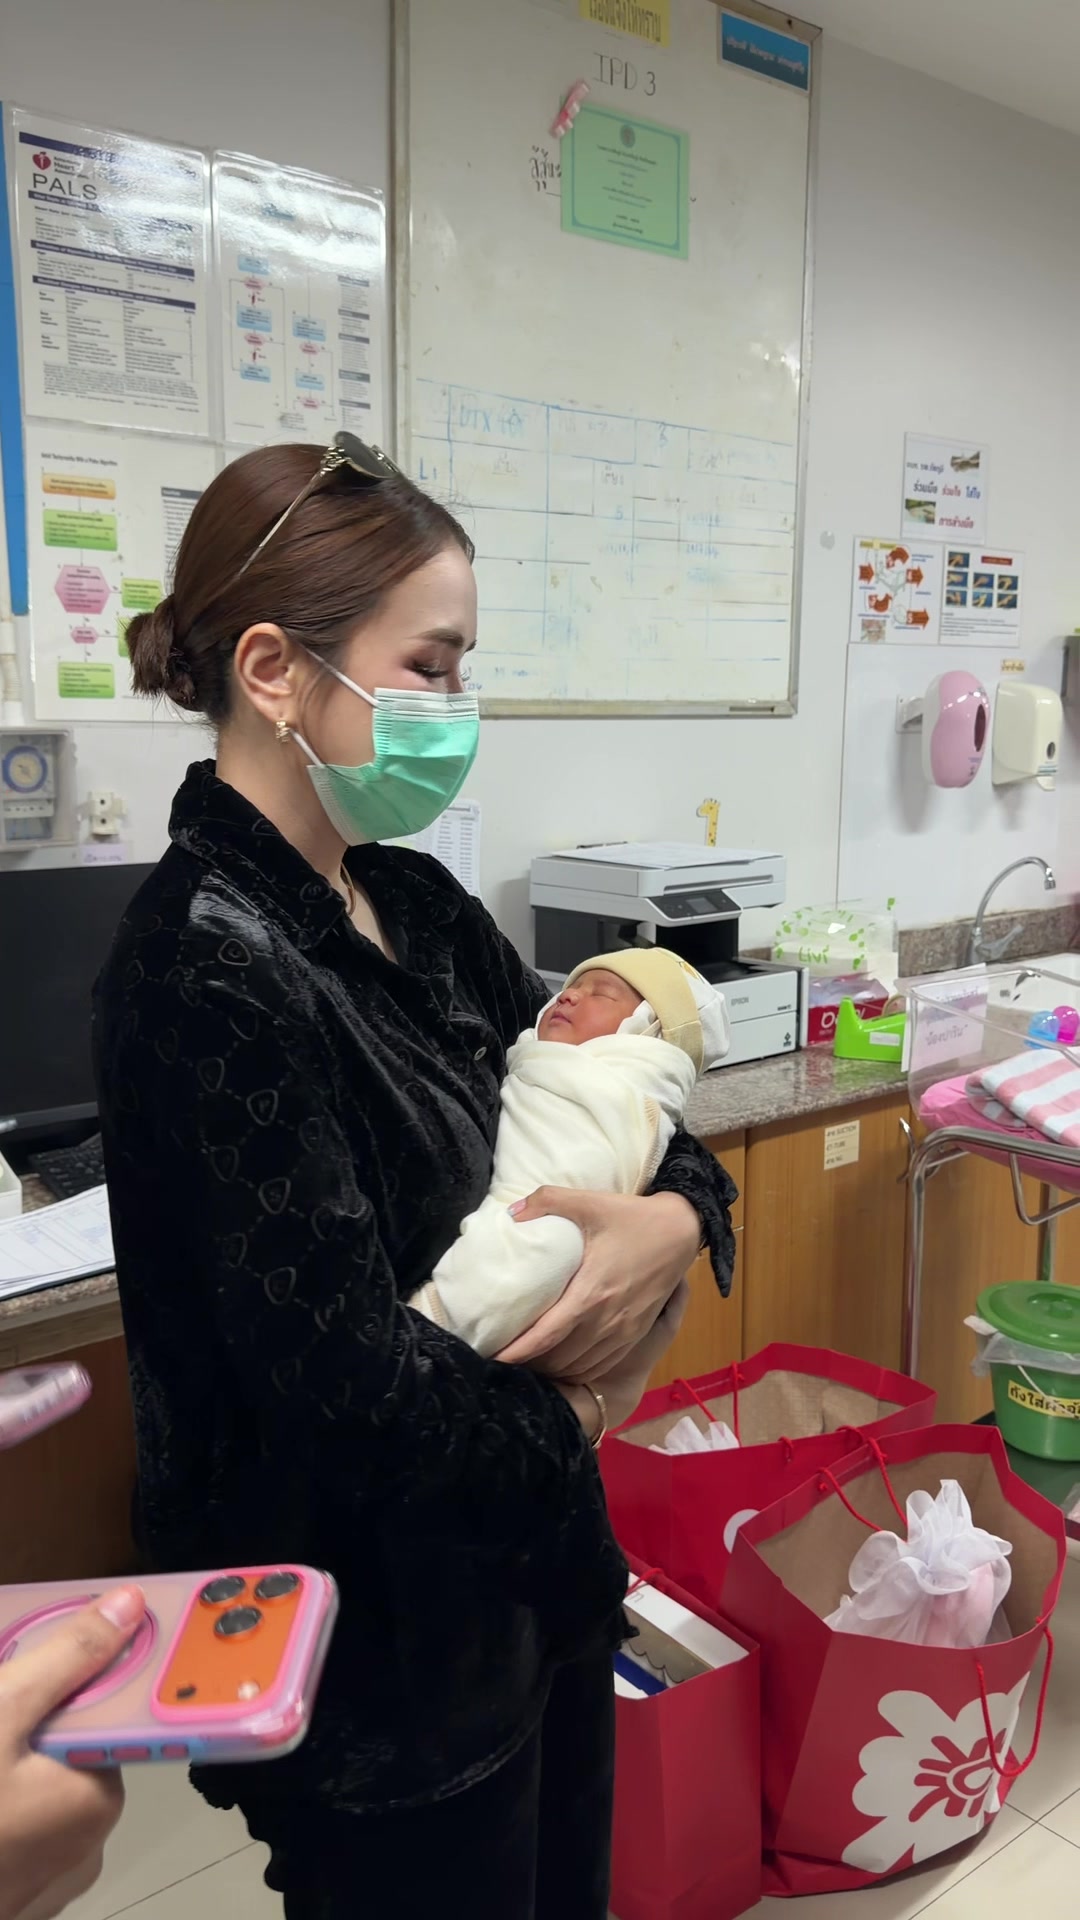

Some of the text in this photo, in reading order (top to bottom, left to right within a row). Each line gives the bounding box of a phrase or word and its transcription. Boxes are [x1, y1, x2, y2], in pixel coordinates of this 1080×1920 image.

[592, 51, 656, 96] IPD 3
[33, 172, 98, 201] PALS
[913, 479, 938, 495] ร่วมมือ
